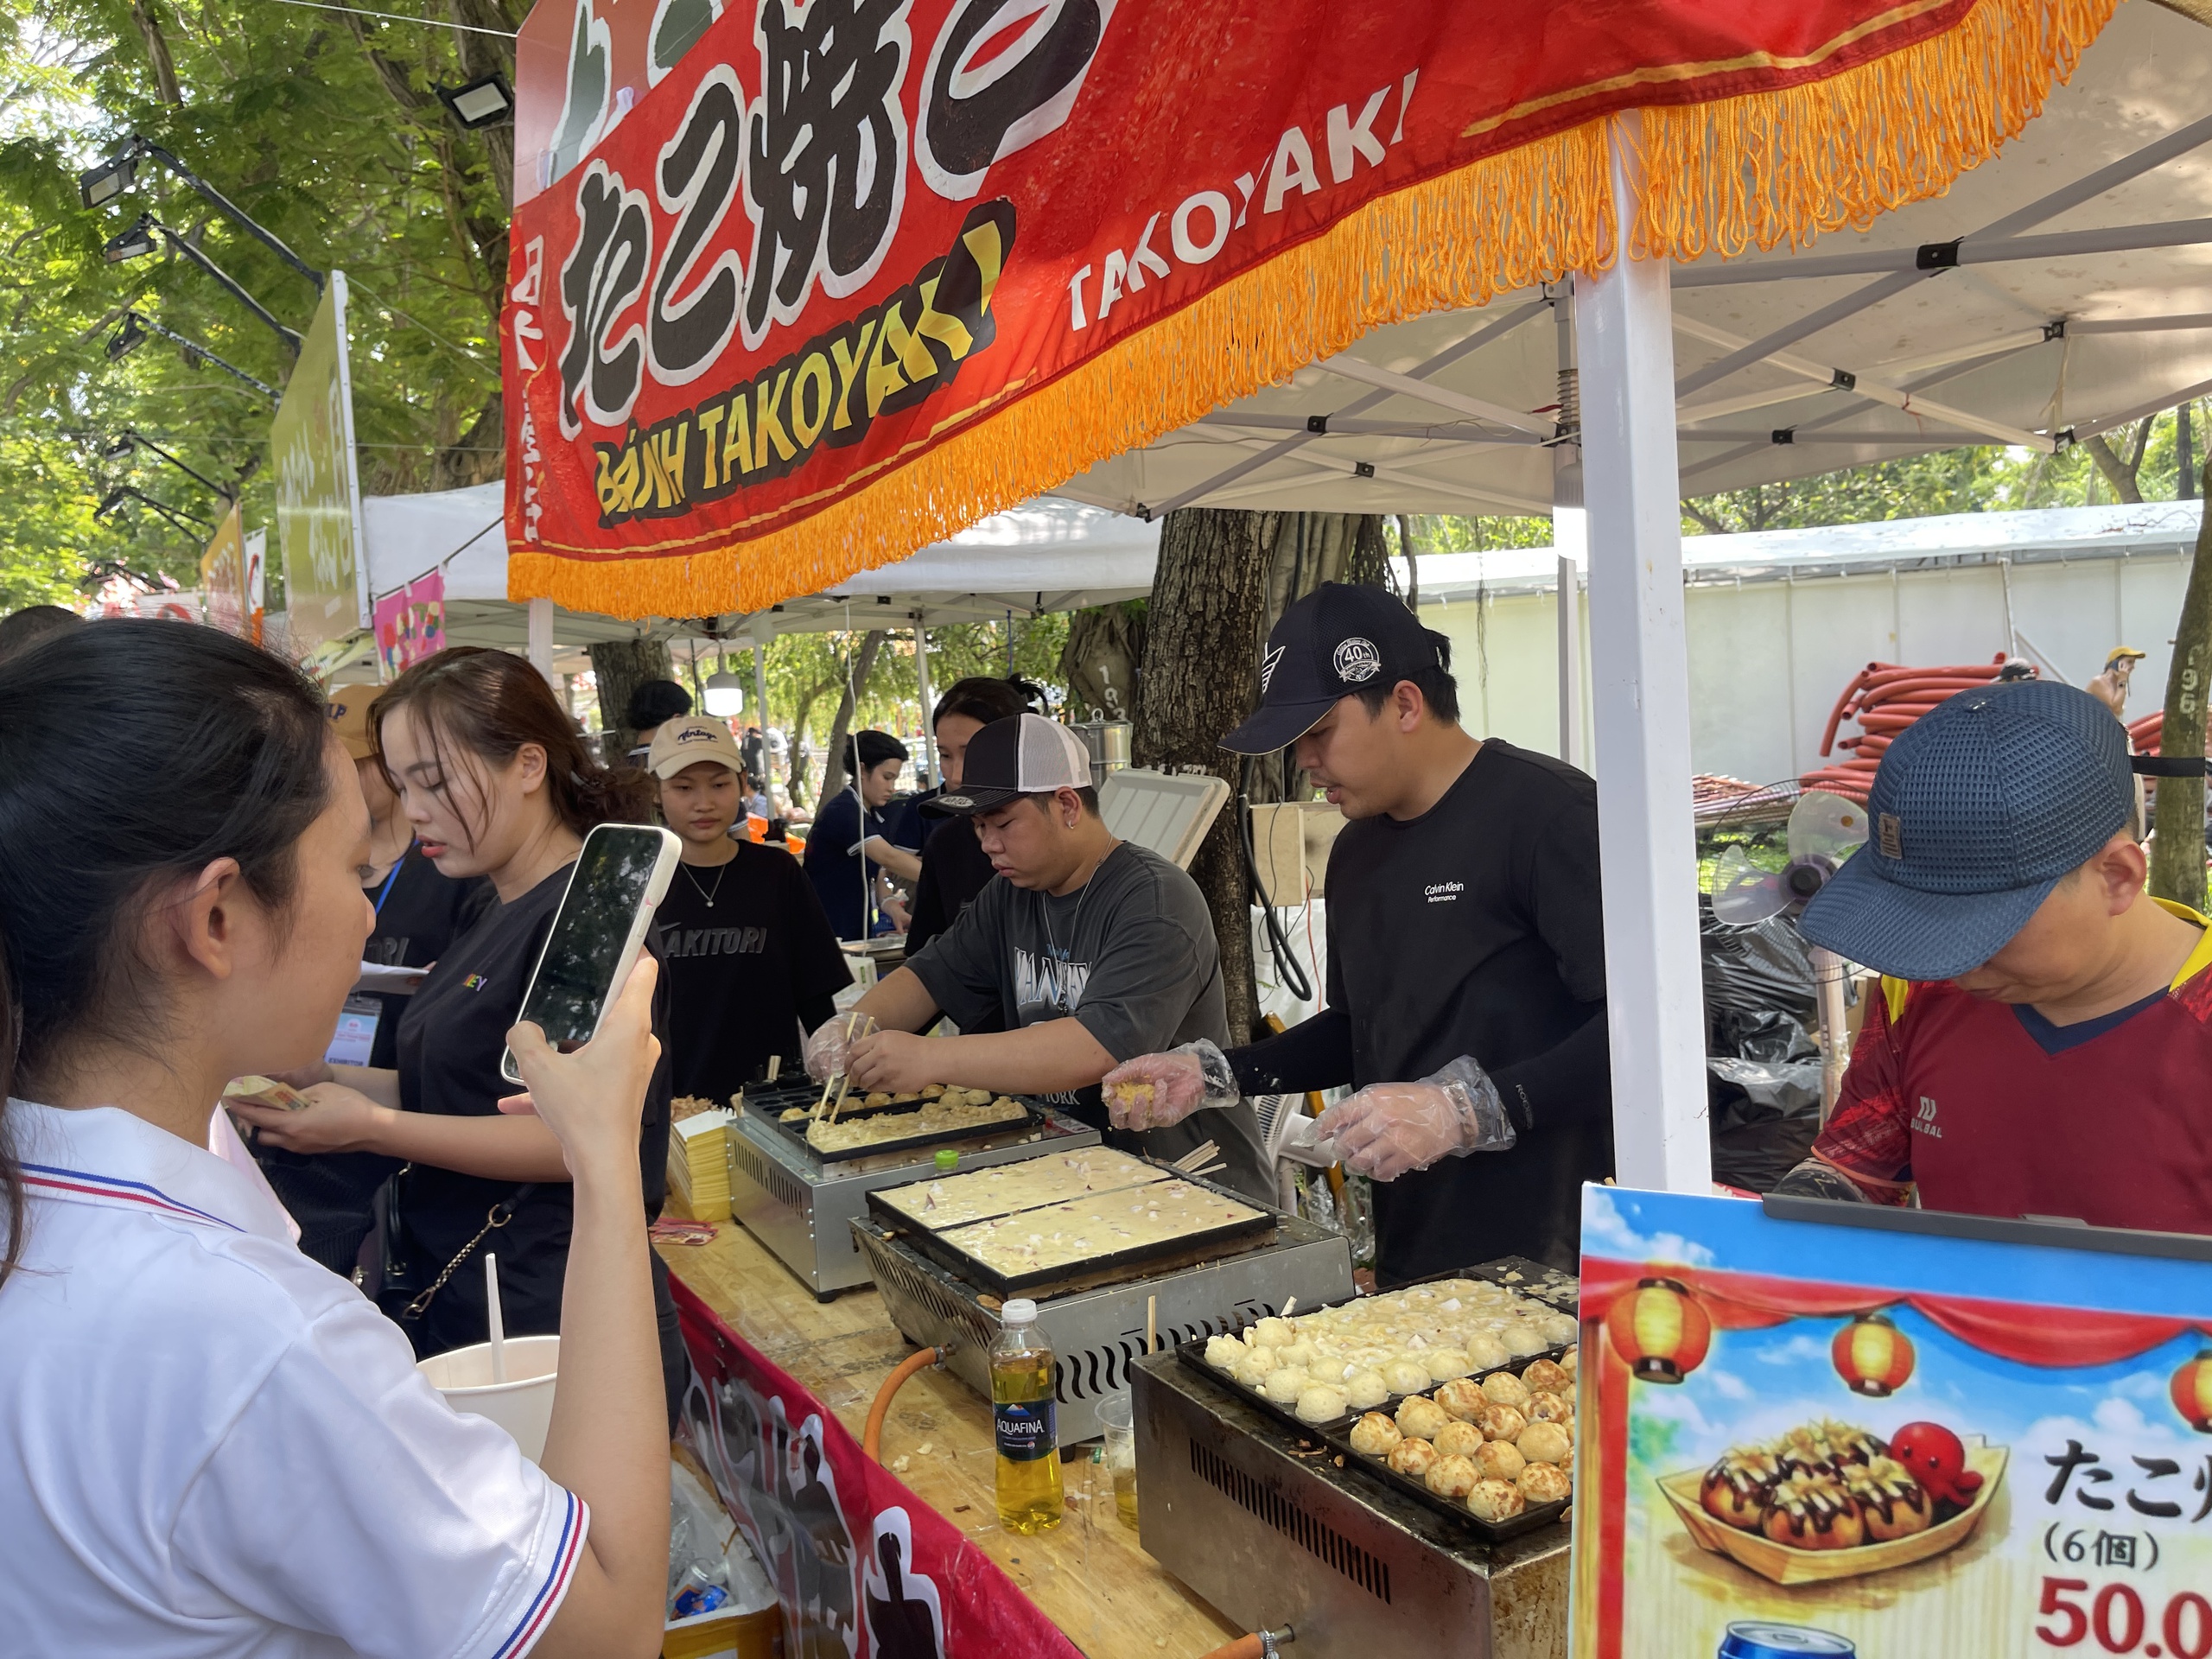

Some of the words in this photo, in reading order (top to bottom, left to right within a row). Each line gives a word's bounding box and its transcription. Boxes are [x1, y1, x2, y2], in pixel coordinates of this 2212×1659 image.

[1066, 67, 1420, 331] TAKOYAKI
[596, 429, 686, 517] BÁNH
[698, 219, 1002, 490] TAKOYAKI
[1344, 645, 1371, 663] 40th
[1424, 883, 1445, 896] Calvin
[1446, 881, 1464, 892] Klein
[996, 1418, 1045, 1435] AQUAFINA
